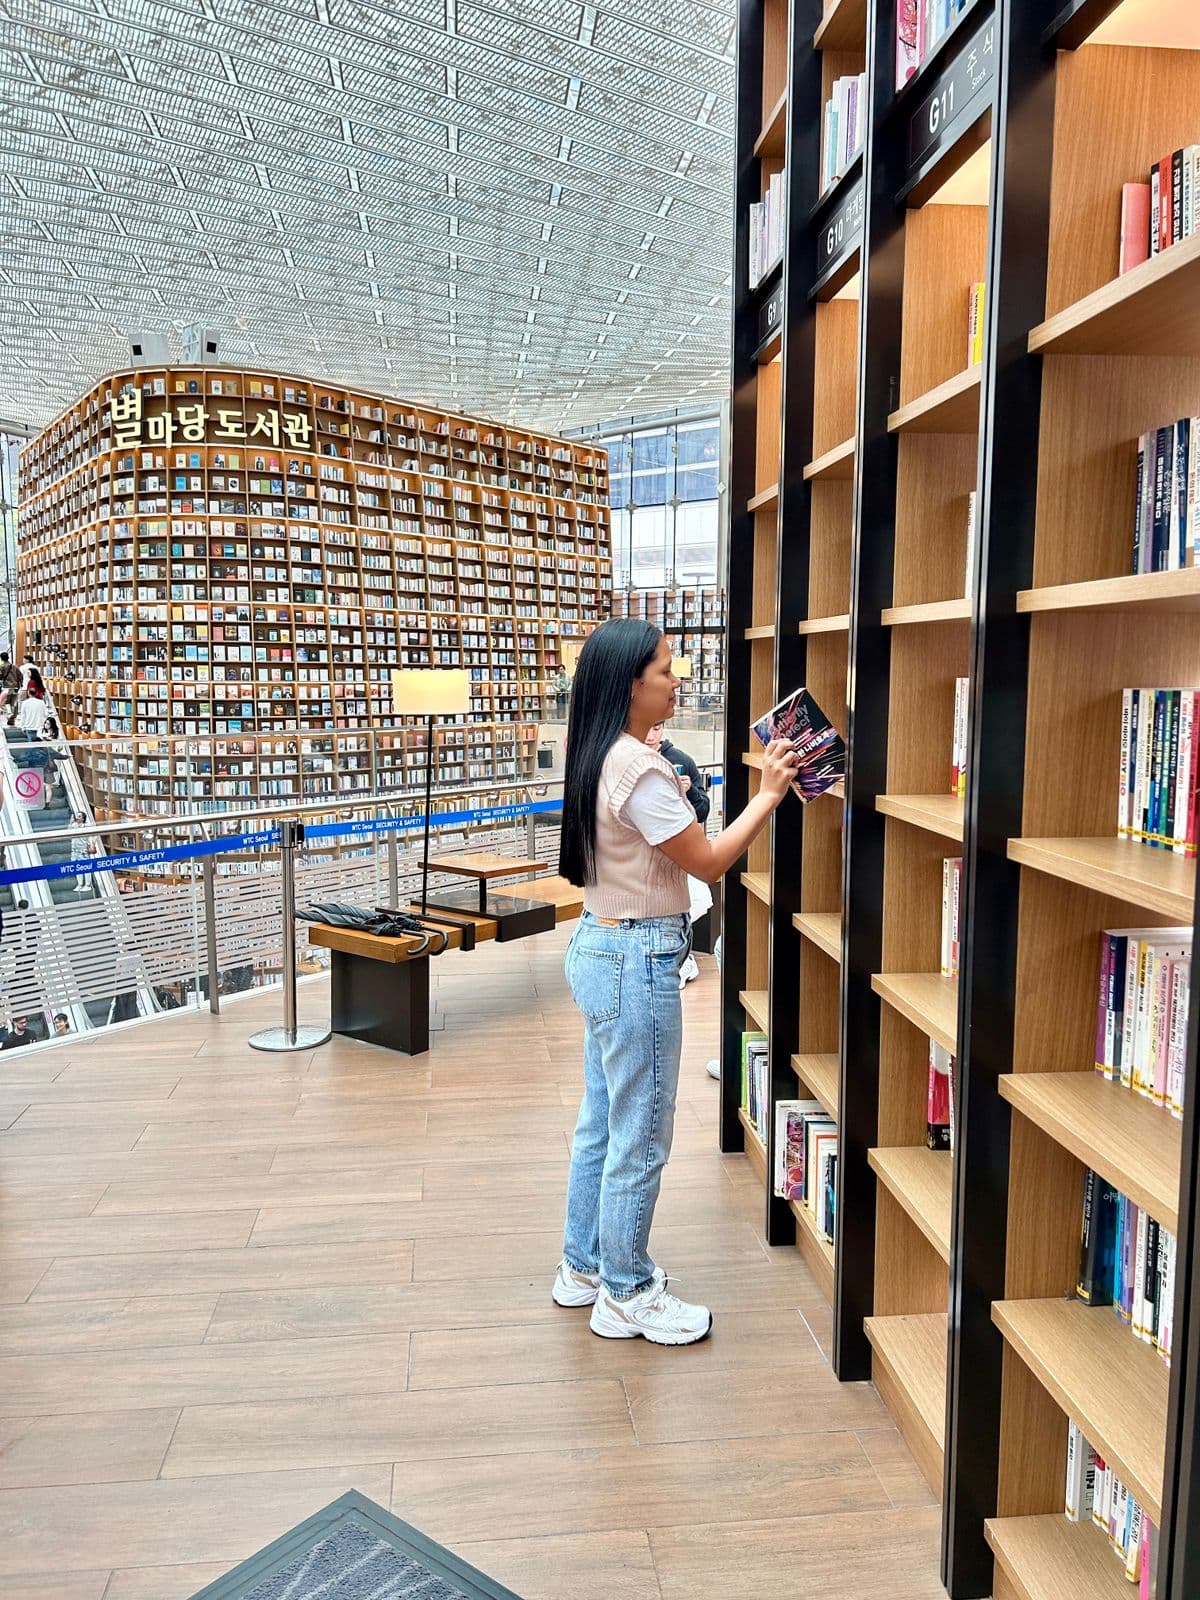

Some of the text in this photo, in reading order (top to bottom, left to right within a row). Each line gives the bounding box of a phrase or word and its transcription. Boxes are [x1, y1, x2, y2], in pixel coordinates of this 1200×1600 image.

[971, 67, 987, 90] Stock
[929, 81, 954, 133] G11
[826, 218, 844, 255] G10
[767, 301, 777, 326] G9
[111, 388, 313, 449] 별마당 도서관
[375, 820, 398, 829] SECURITY
[403, 818, 421, 826] SAFETY
[60, 864, 75, 873] WTC
[76, 862, 93, 872] Seoul
[96, 857, 130, 869] SECURITY
[139, 851, 165, 862] SAFETY
